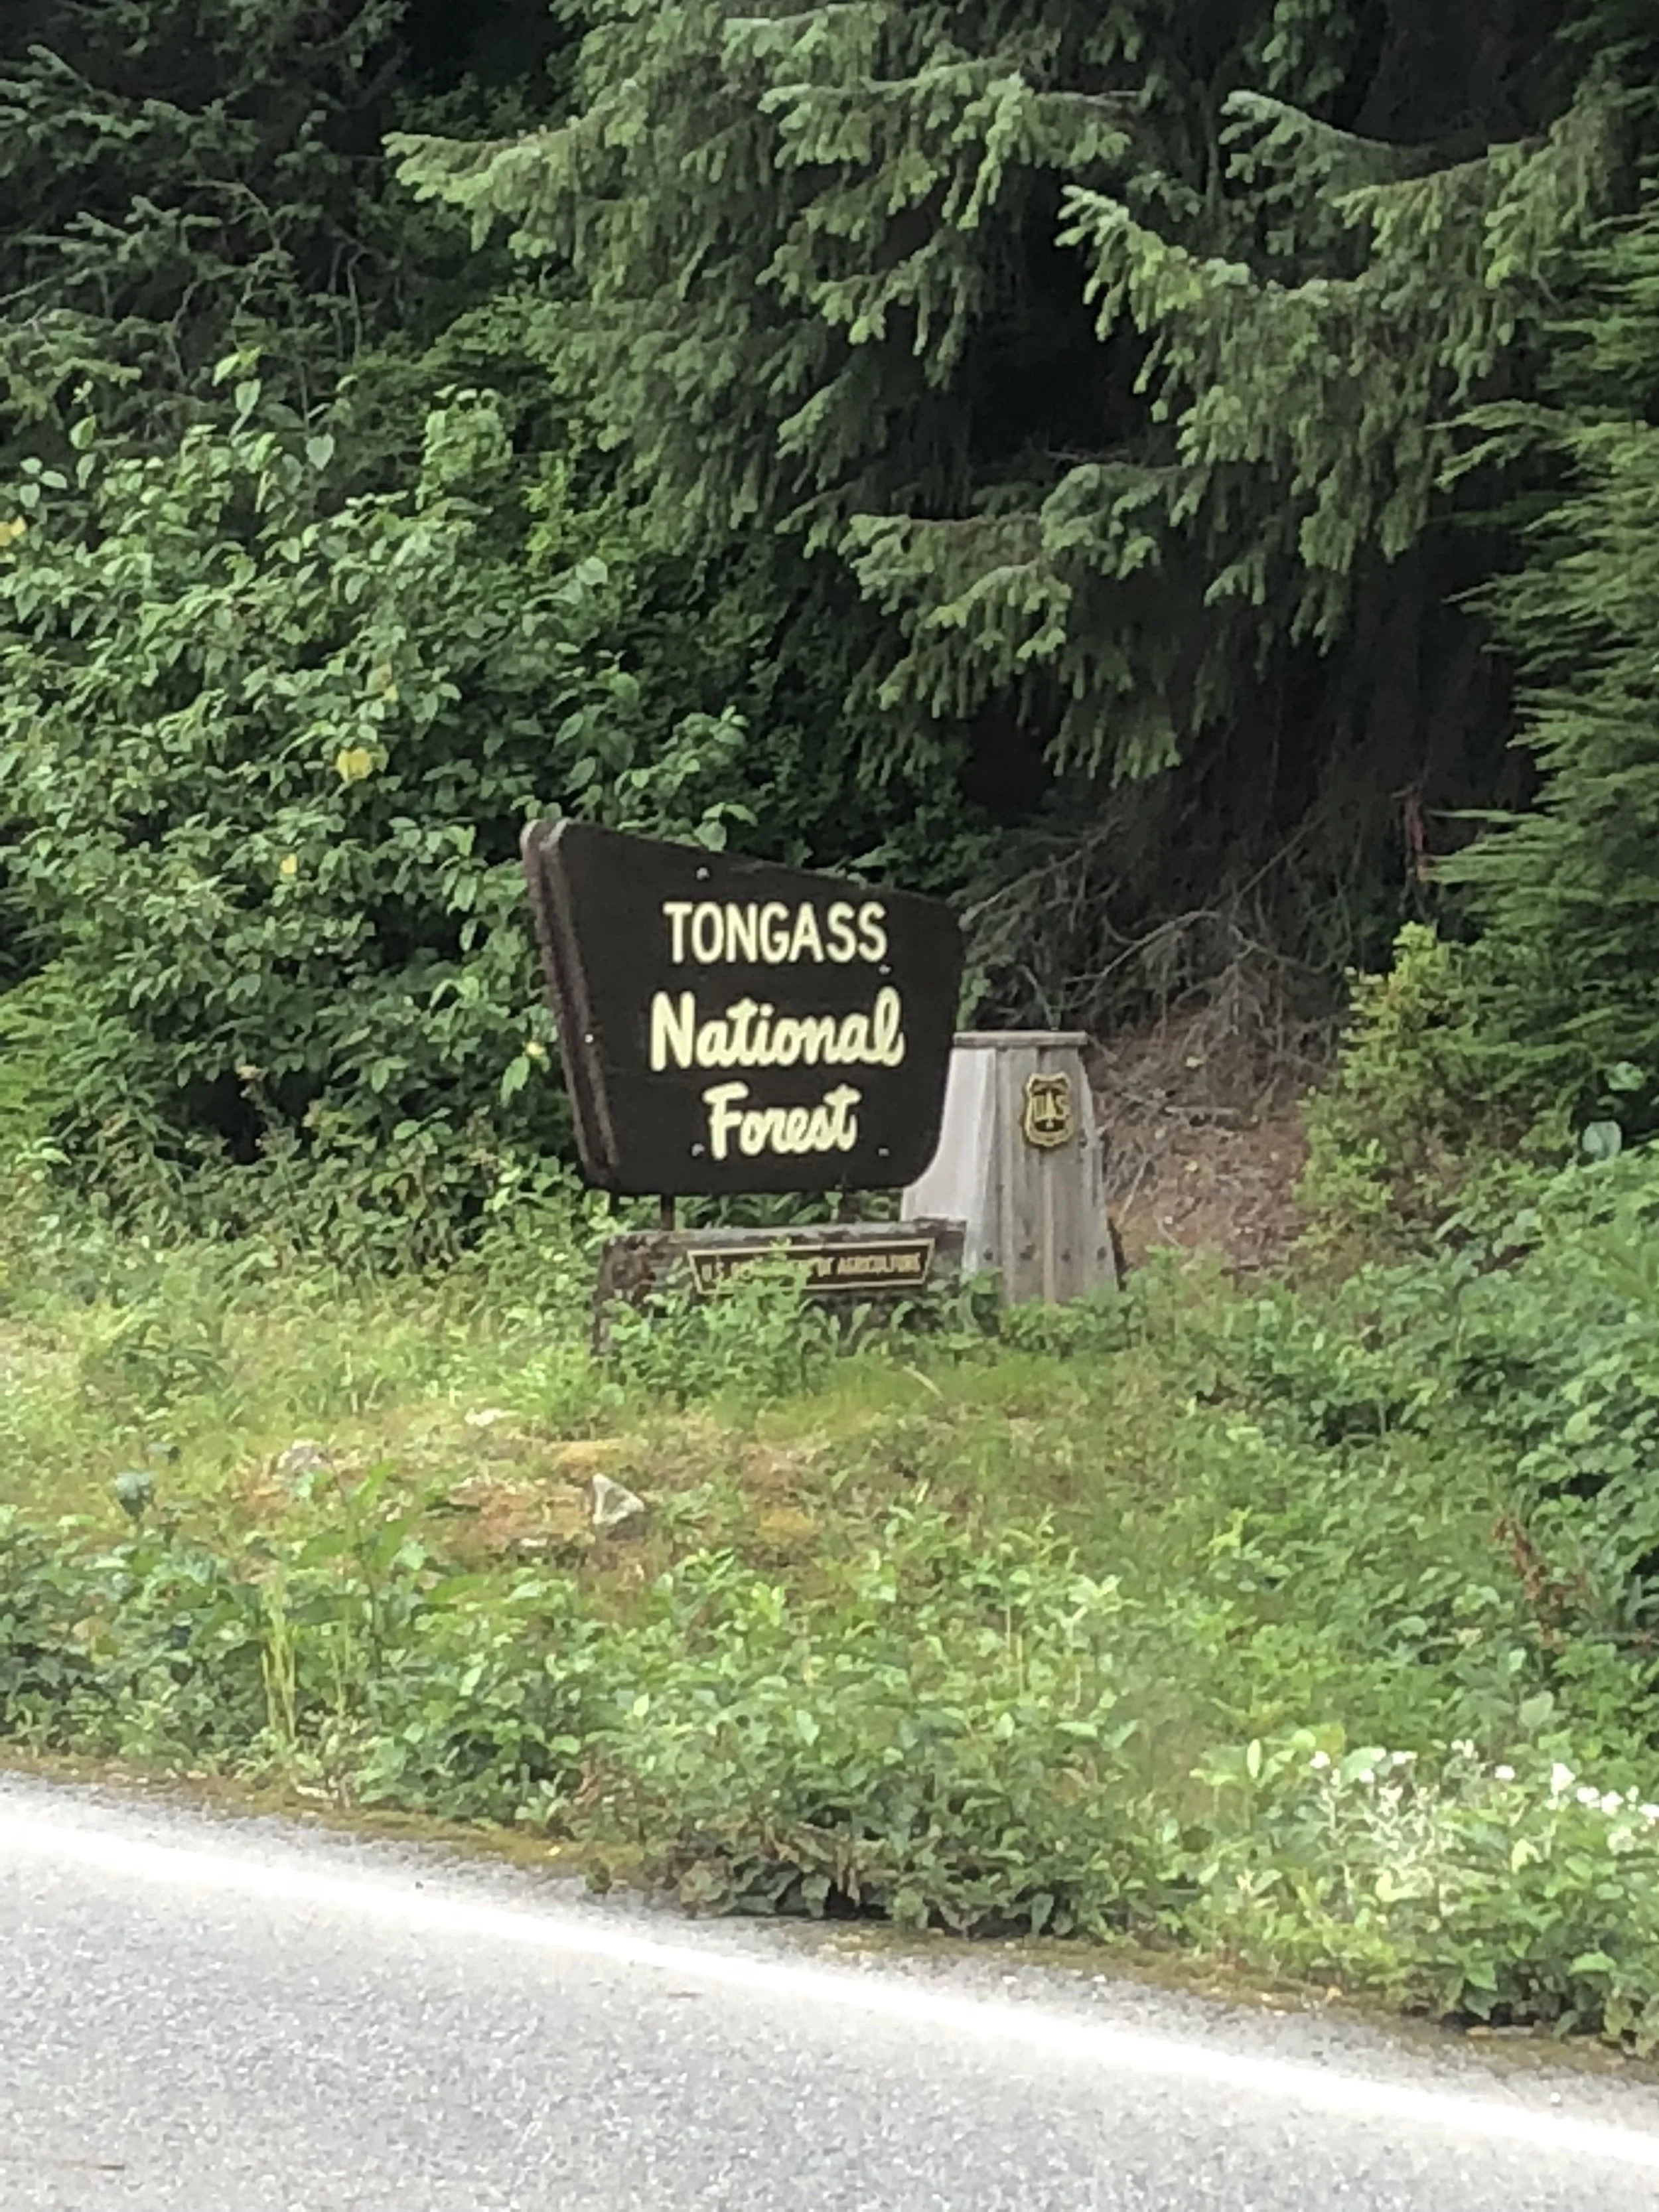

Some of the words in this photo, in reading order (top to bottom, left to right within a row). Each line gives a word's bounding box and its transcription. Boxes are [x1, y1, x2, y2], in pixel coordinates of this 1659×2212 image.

[662, 901, 887, 964] TONGASS
[650, 986, 905, 1072] National
[702, 1081, 862, 1160] Forest
